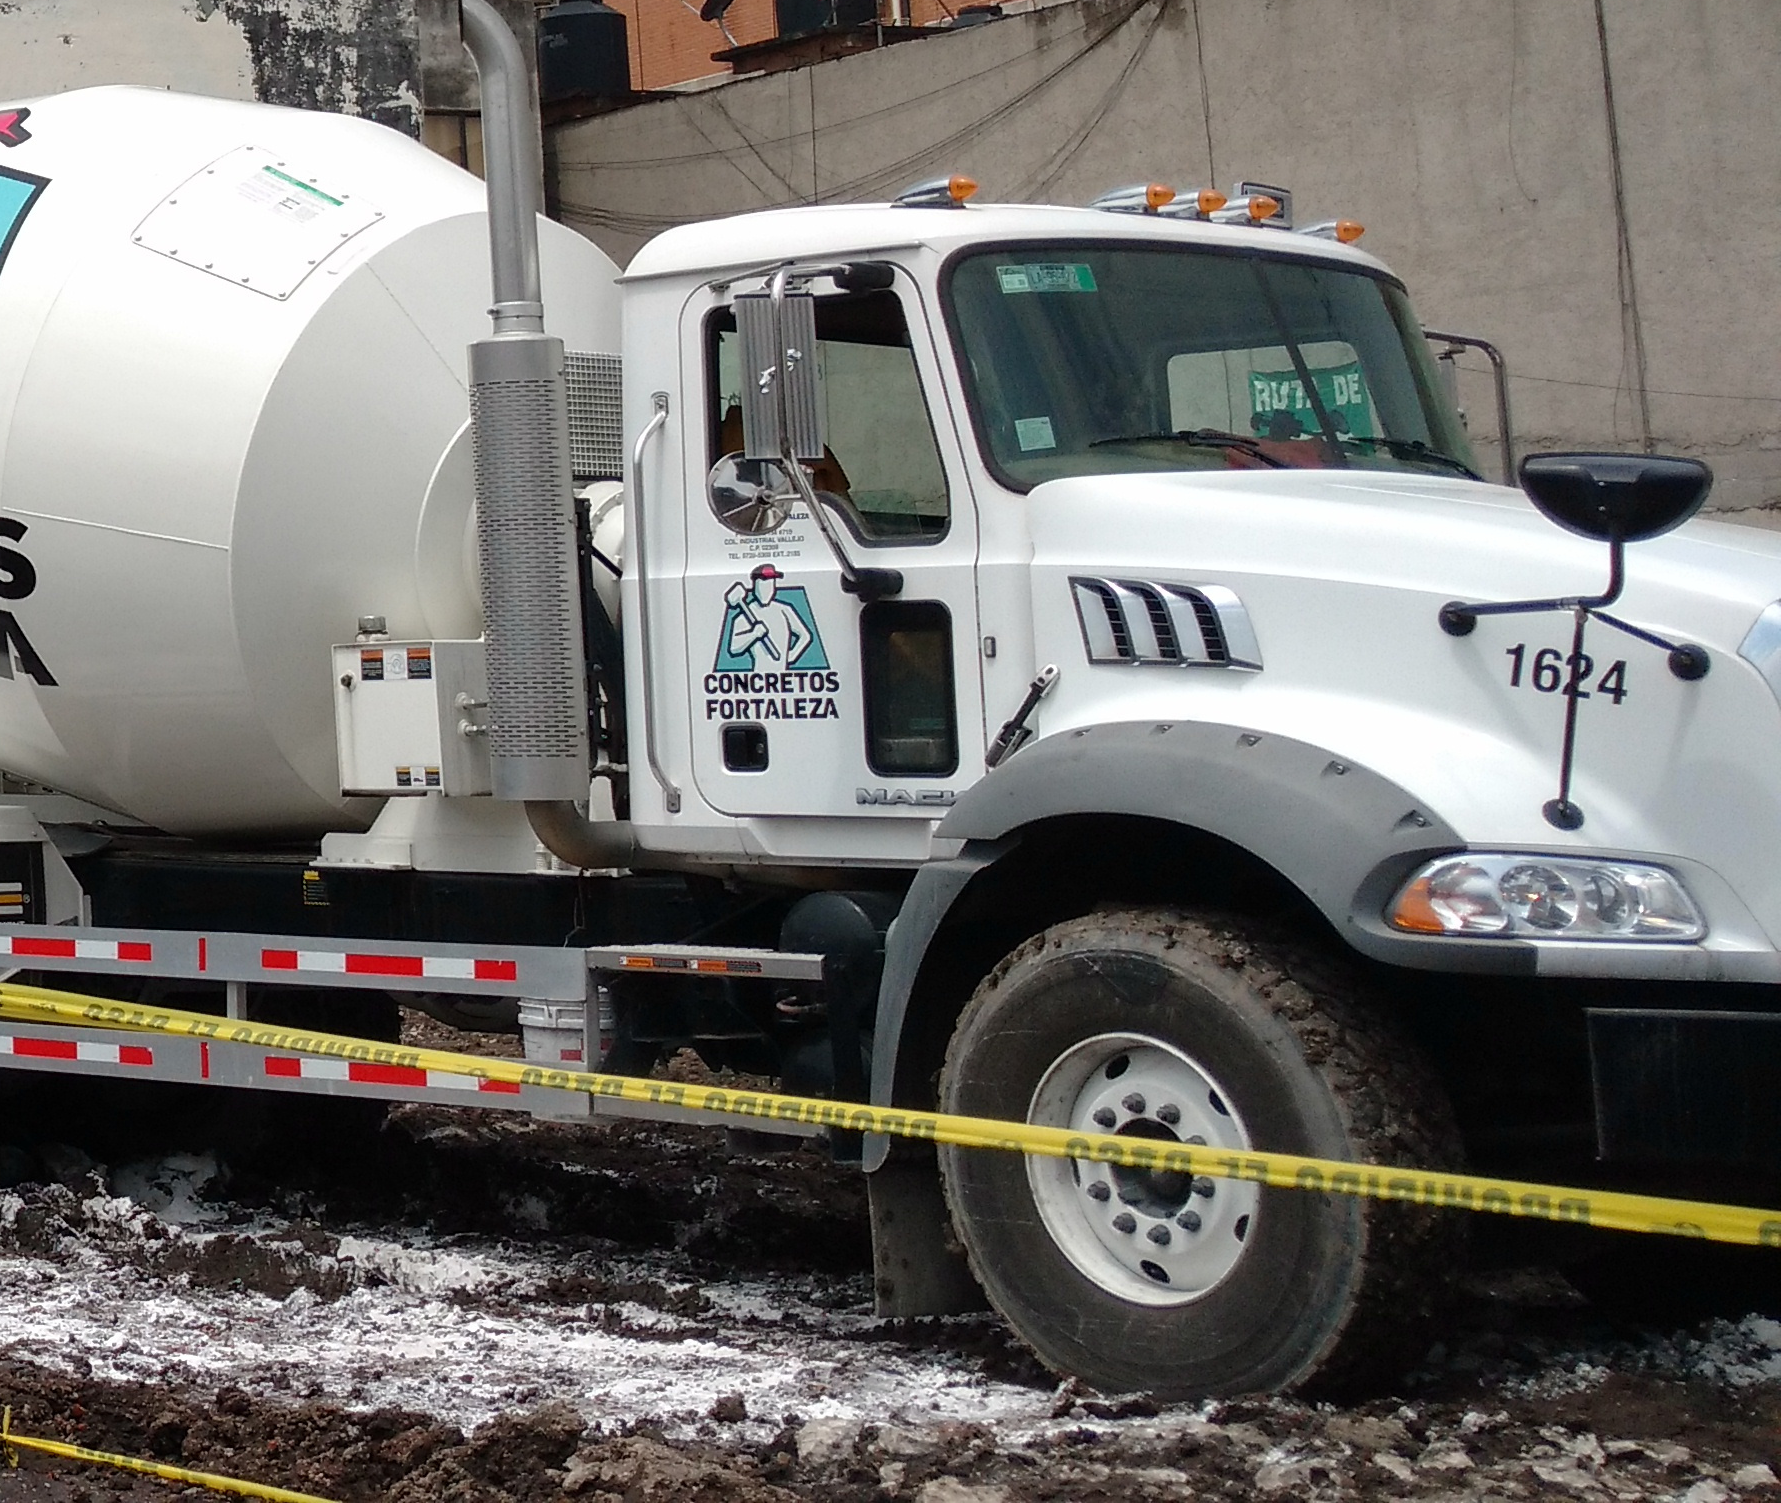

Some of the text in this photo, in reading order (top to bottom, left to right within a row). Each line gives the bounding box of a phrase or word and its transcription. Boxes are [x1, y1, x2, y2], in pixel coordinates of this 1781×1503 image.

[1333, 373, 1362, 406] DE
[703, 671, 840, 694] CONCRETOS
[1505, 642, 1628, 705] 1624
[706, 697, 839, 720] FORTALEZA
